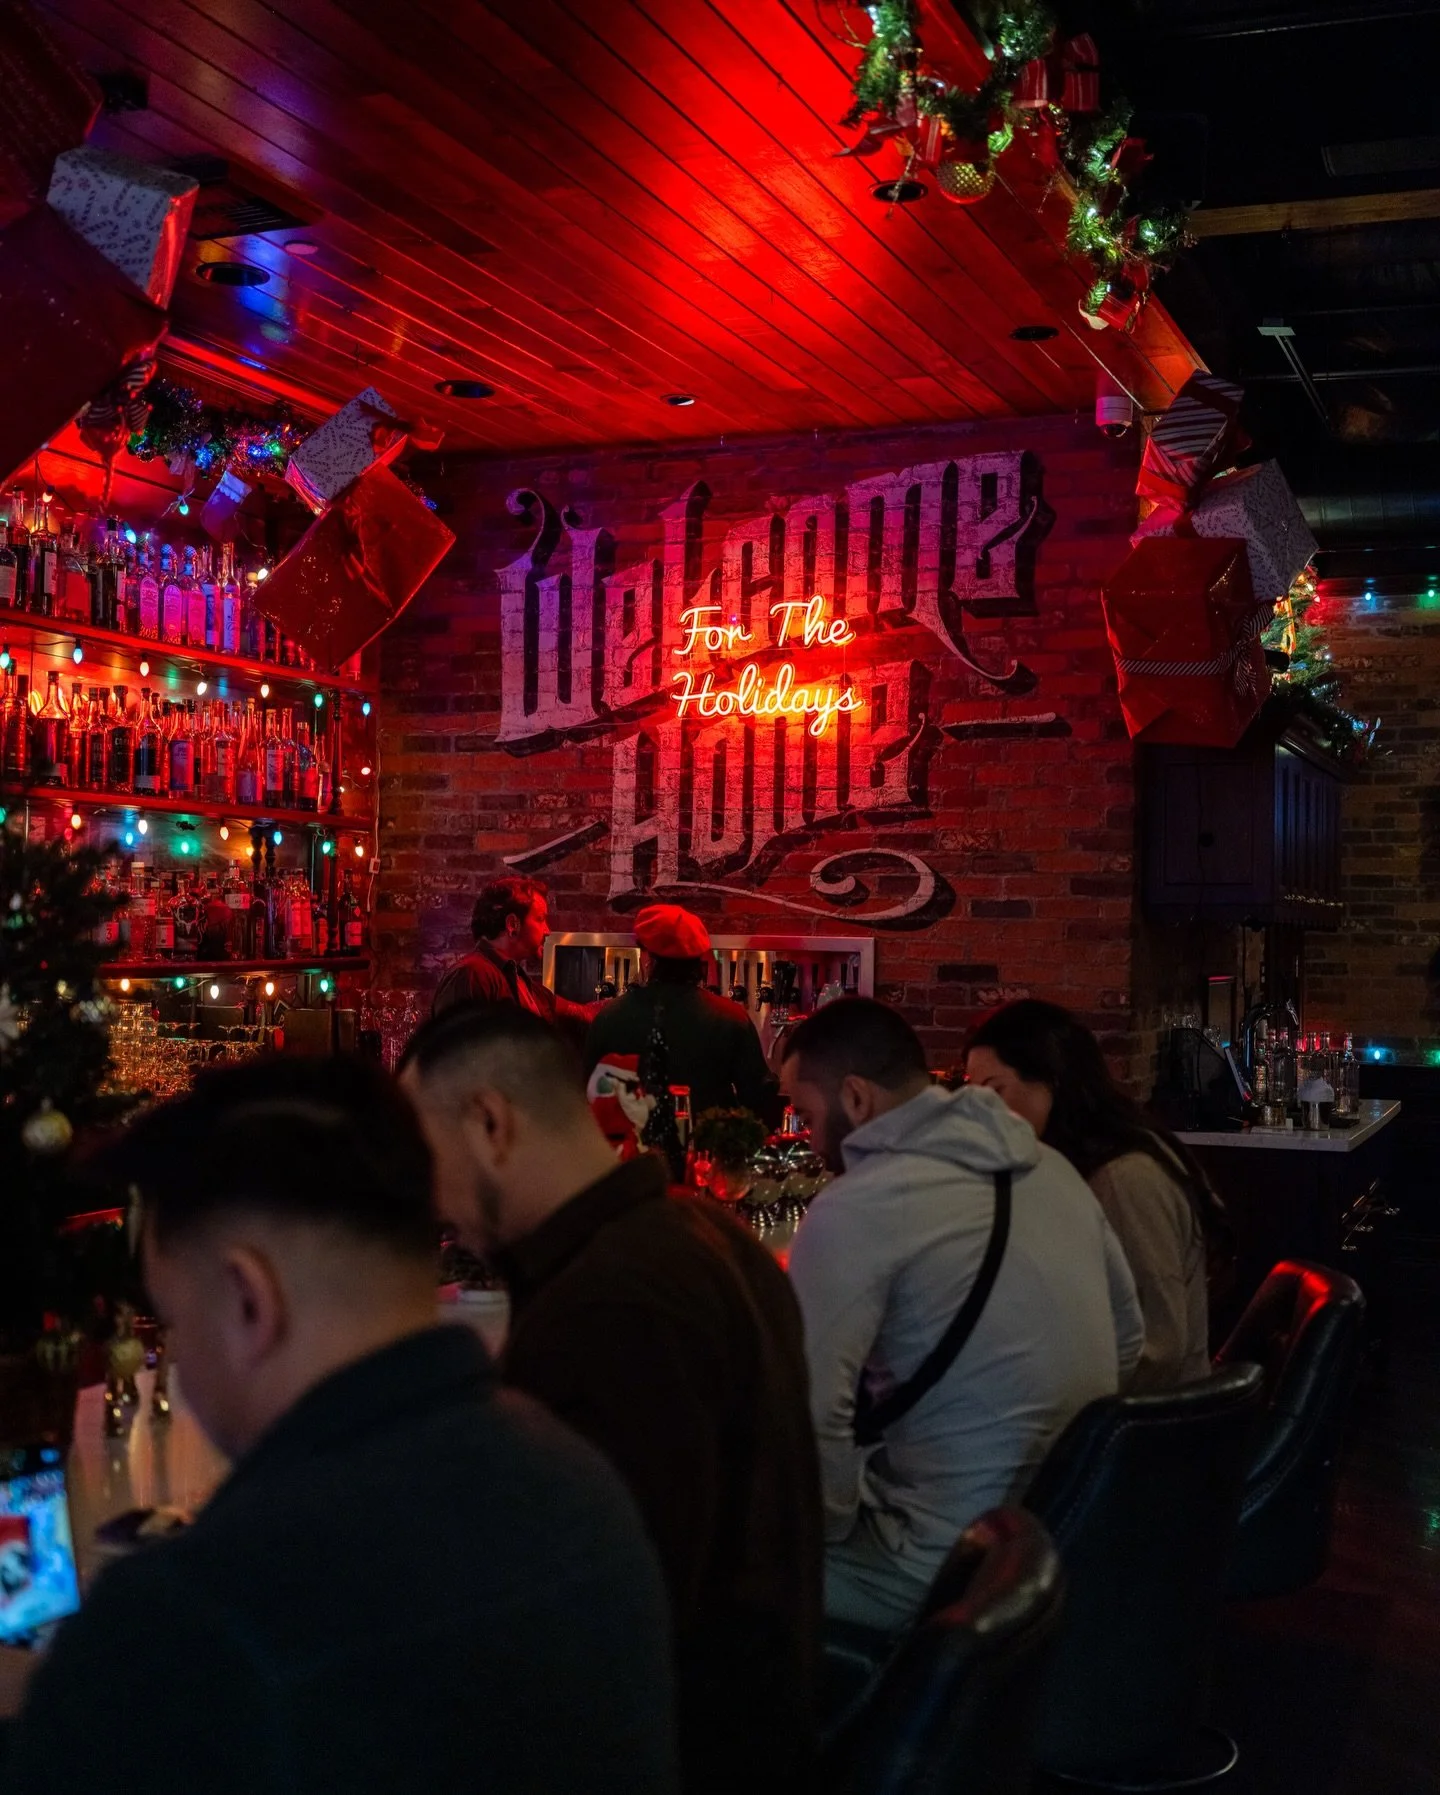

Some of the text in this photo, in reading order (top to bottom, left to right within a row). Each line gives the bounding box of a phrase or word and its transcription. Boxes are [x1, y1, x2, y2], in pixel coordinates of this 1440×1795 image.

[494, 449, 1038, 744] Welcome
[673, 595, 853, 655] For The
[672, 663, 863, 736] Holidays
[606, 659, 934, 910] Home
